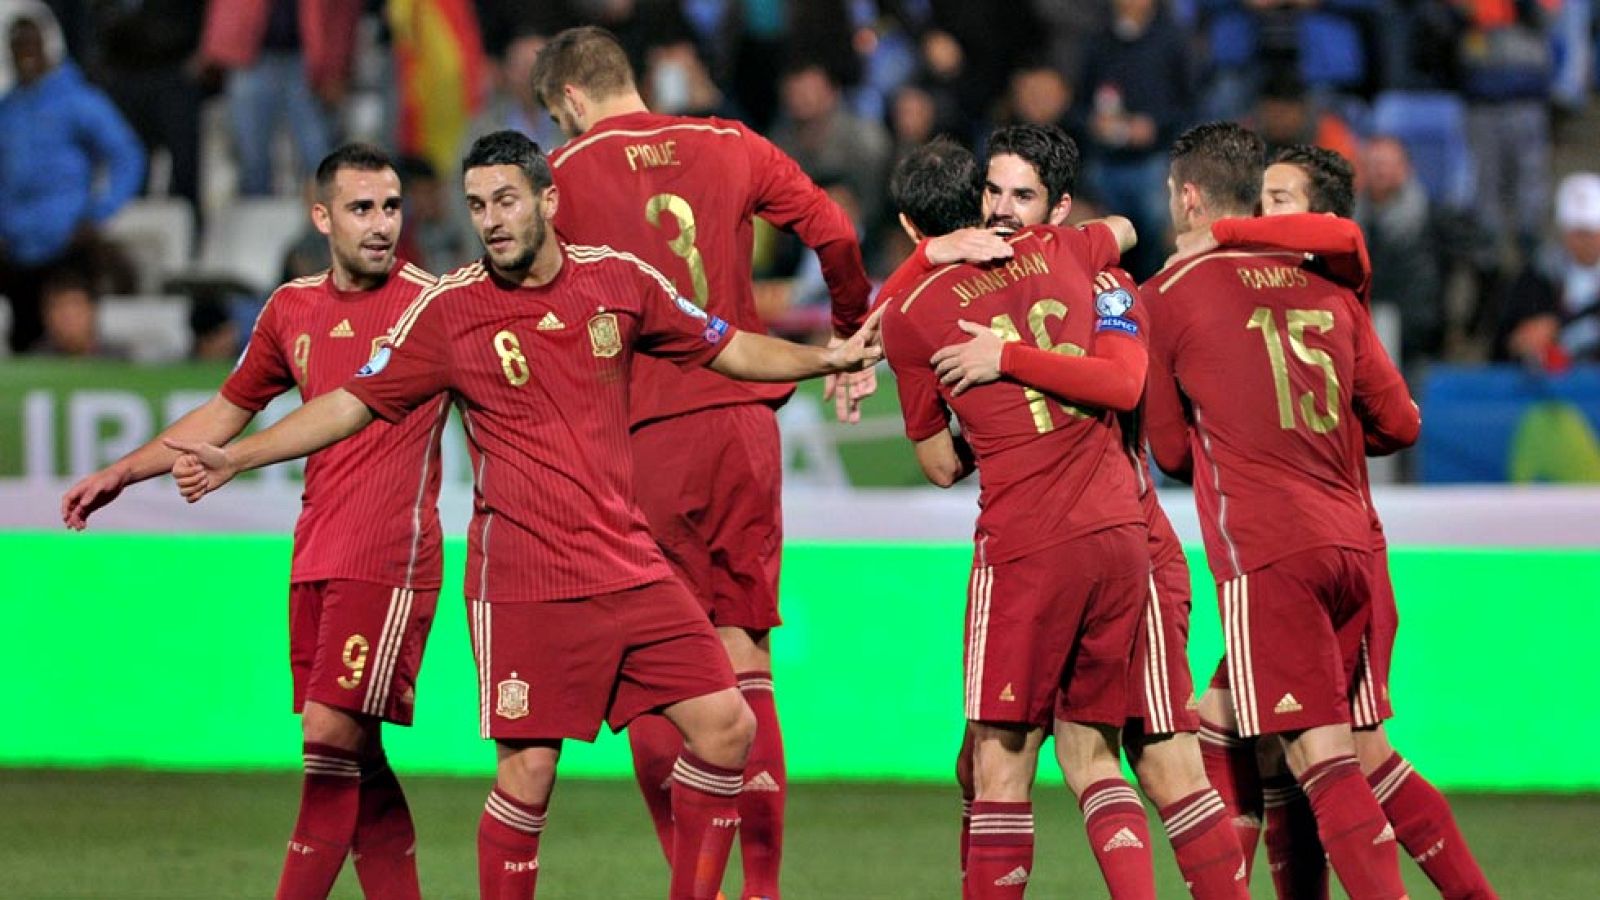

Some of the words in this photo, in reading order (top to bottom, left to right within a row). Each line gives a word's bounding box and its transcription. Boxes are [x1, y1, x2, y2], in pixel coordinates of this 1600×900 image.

[645, 193, 709, 310] 3
[952, 252, 1049, 307] JUANFRAN
[1237, 265, 1308, 289] RAMOS
[294, 333, 311, 389] 9
[493, 330, 530, 387] 8
[1246, 306, 1339, 434] 15
[336, 634, 370, 690] 9
